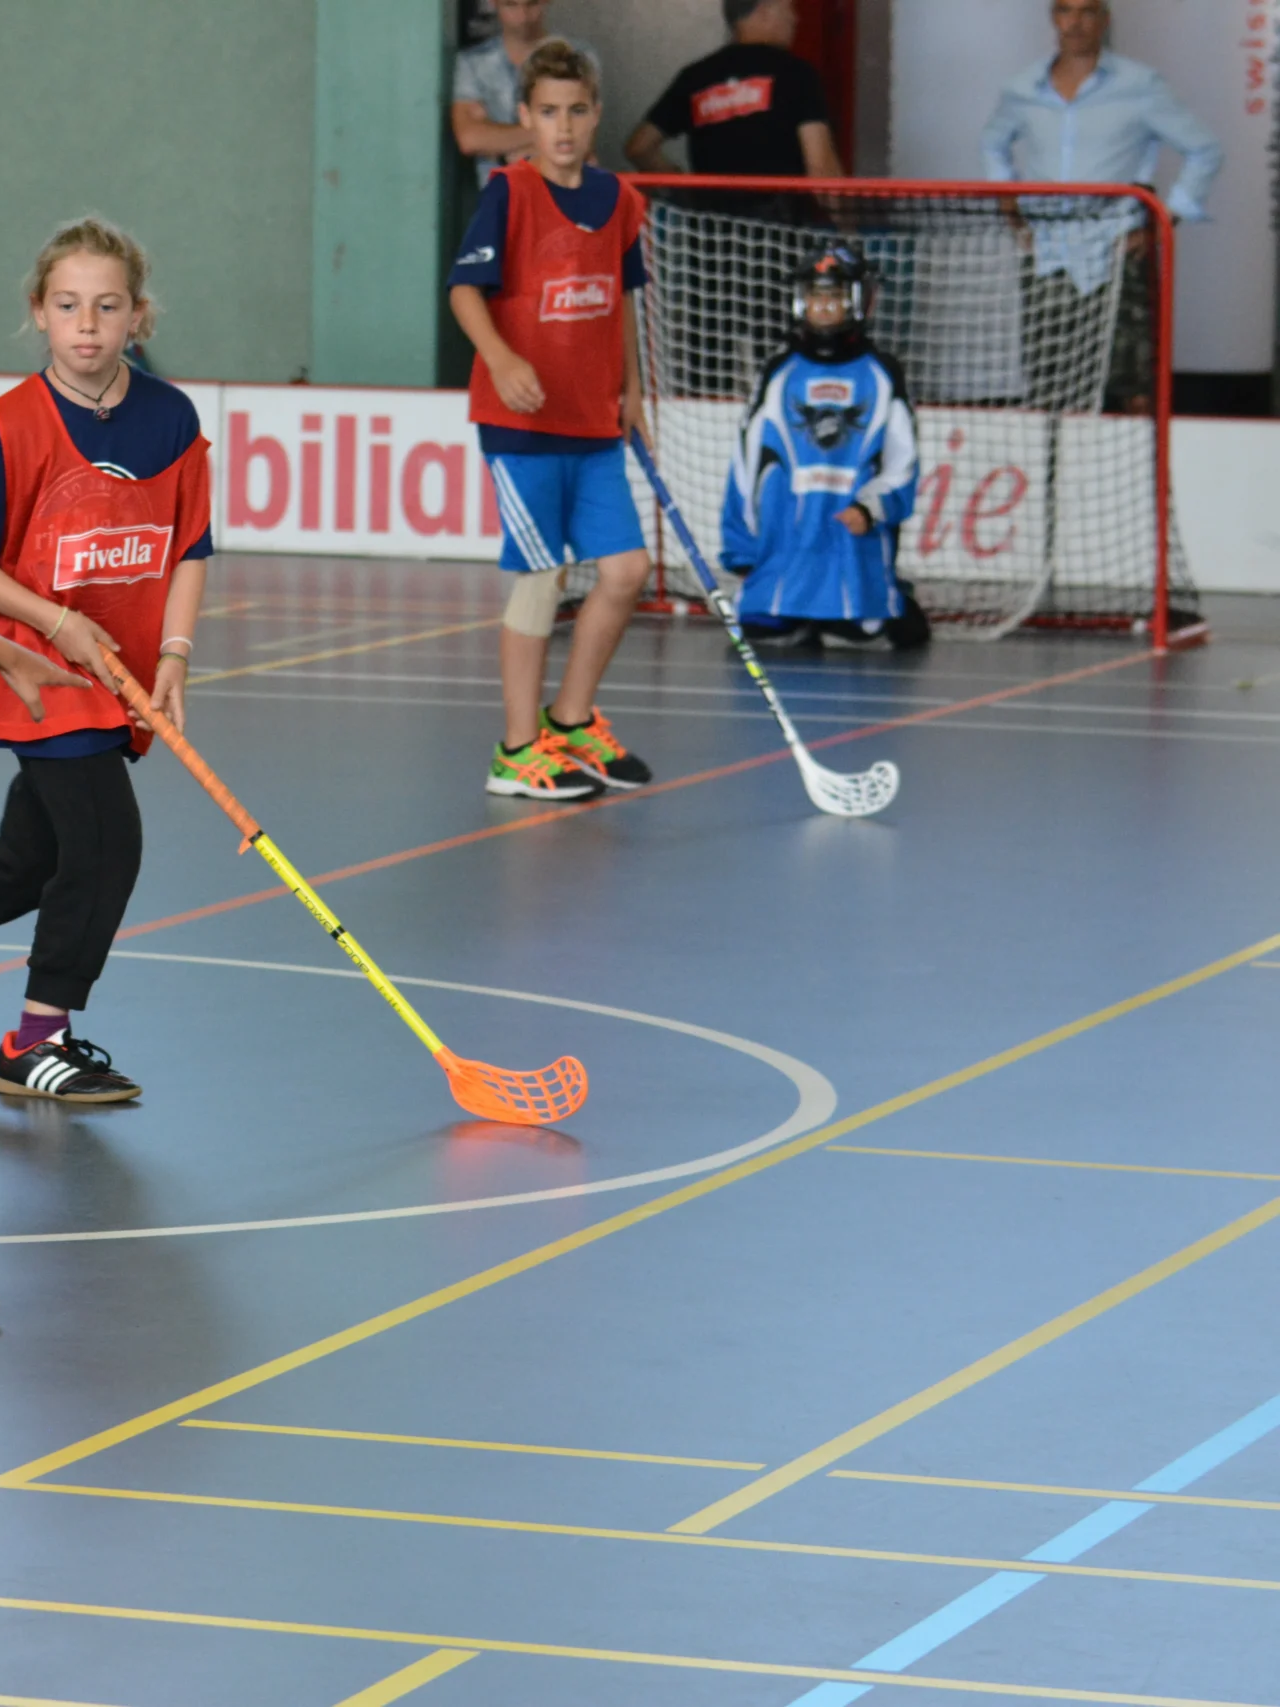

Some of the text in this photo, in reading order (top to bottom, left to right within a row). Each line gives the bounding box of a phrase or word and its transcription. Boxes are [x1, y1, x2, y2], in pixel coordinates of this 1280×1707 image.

[224, 410, 502, 538] bilia
[915, 426, 1030, 560] ie
[72, 535, 152, 573] rivella
